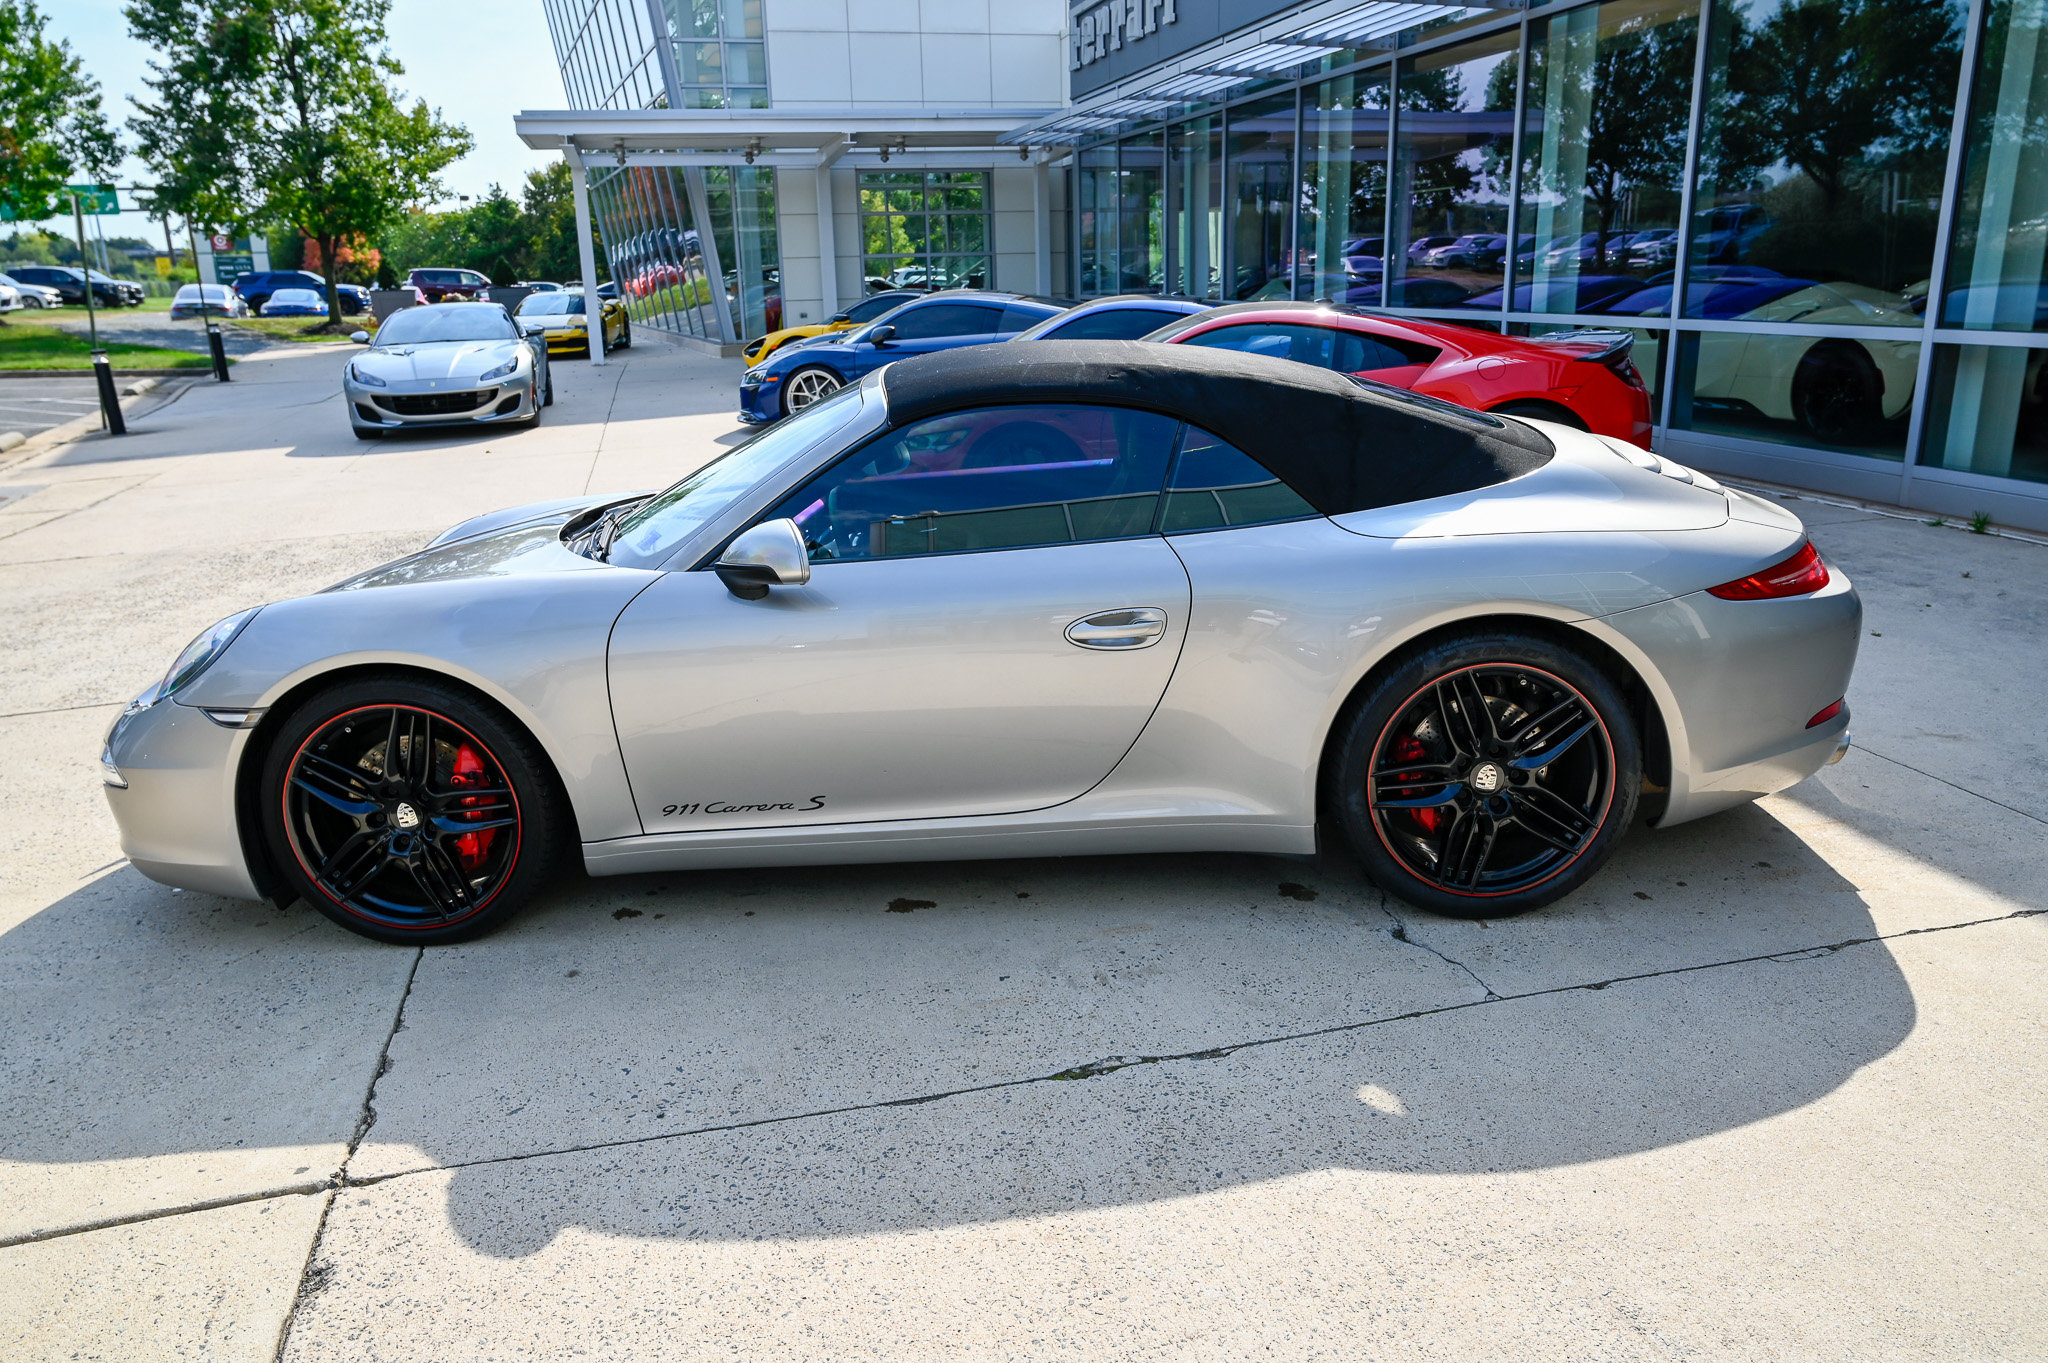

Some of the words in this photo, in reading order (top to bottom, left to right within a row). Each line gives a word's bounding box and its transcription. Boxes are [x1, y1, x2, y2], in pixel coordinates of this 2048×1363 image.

[662, 803, 700, 816] 911
[704, 801, 794, 814] Carrera
[798, 795, 826, 811] S
